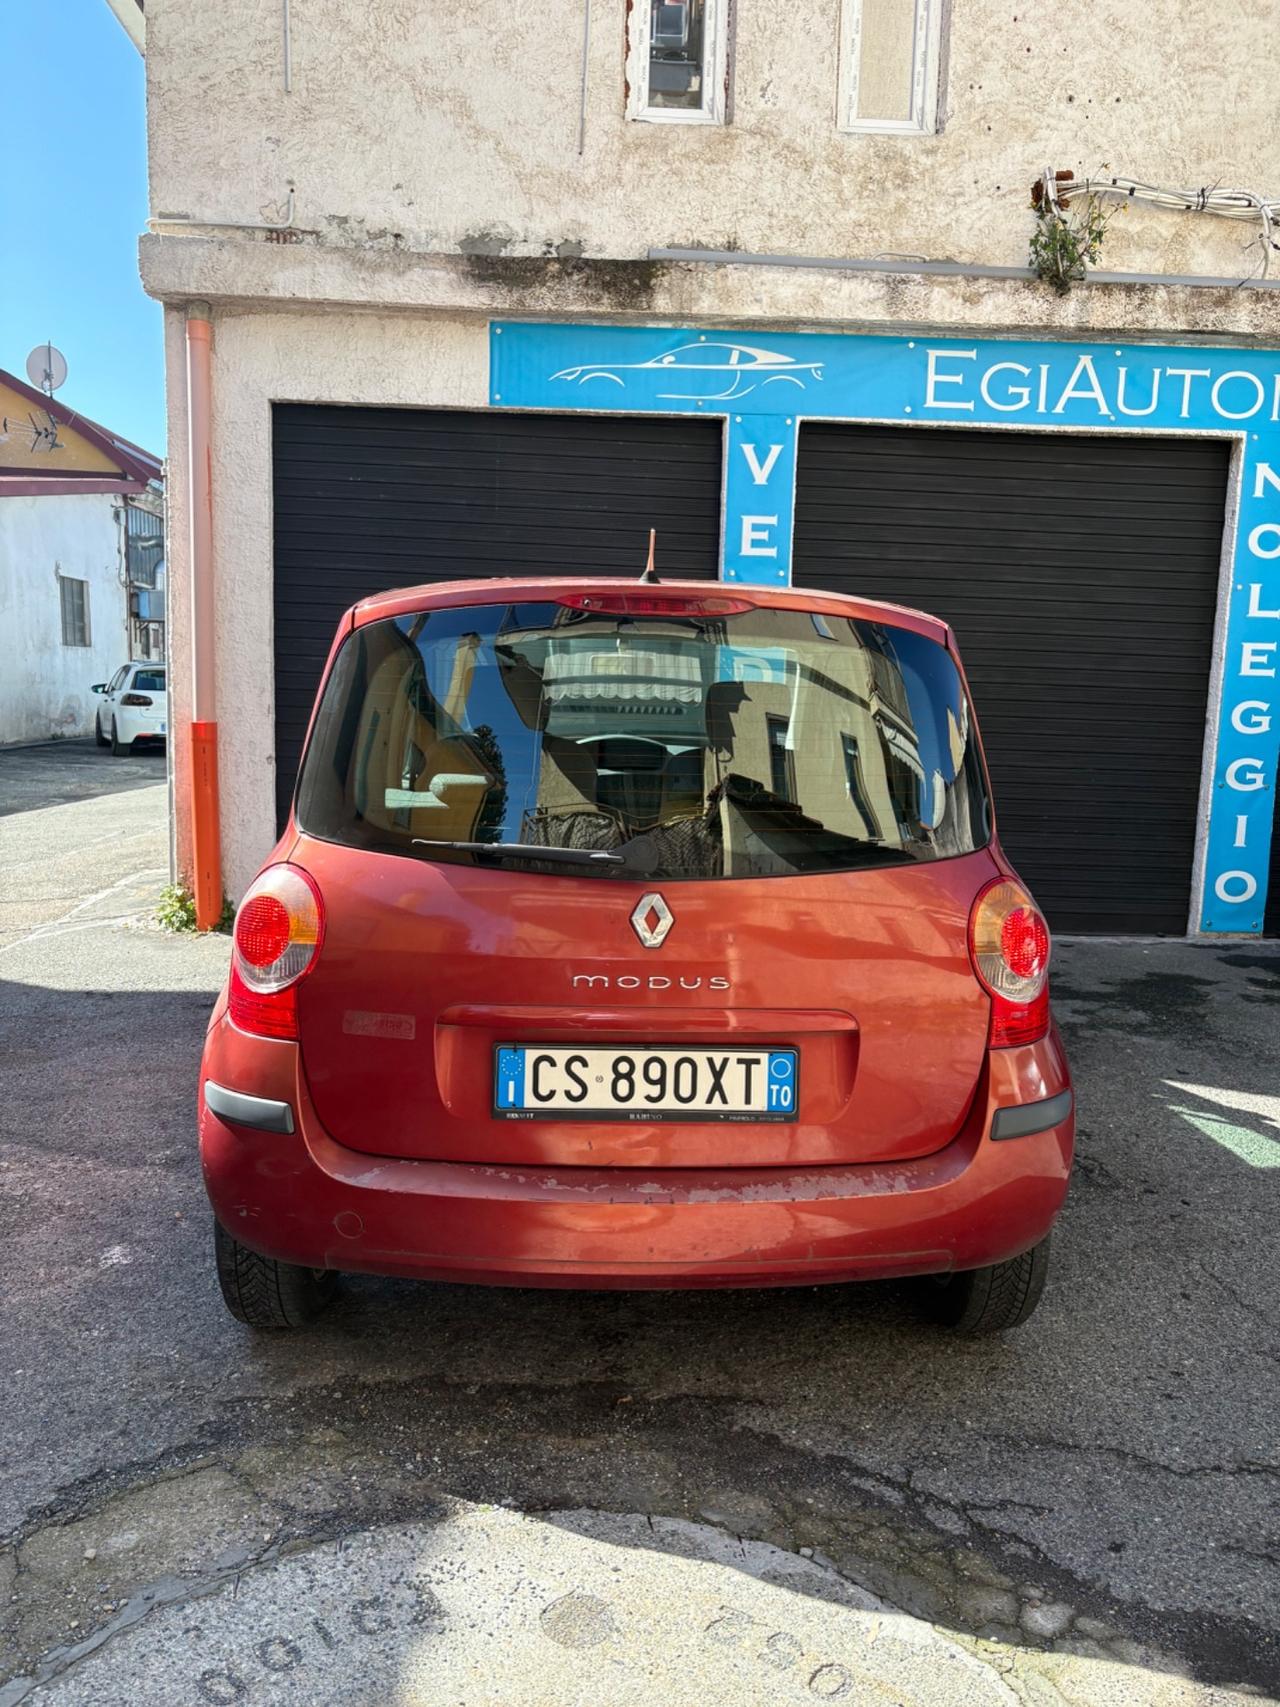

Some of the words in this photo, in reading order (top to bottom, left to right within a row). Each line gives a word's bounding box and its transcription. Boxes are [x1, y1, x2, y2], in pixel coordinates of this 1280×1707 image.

[923, 348, 1280, 421] EGIAUTO
[572, 974, 731, 990] MODUS
[531, 1054, 590, 1103] CS
[610, 1055, 762, 1106] 890XT
[770, 1084, 791, 1107] TO
